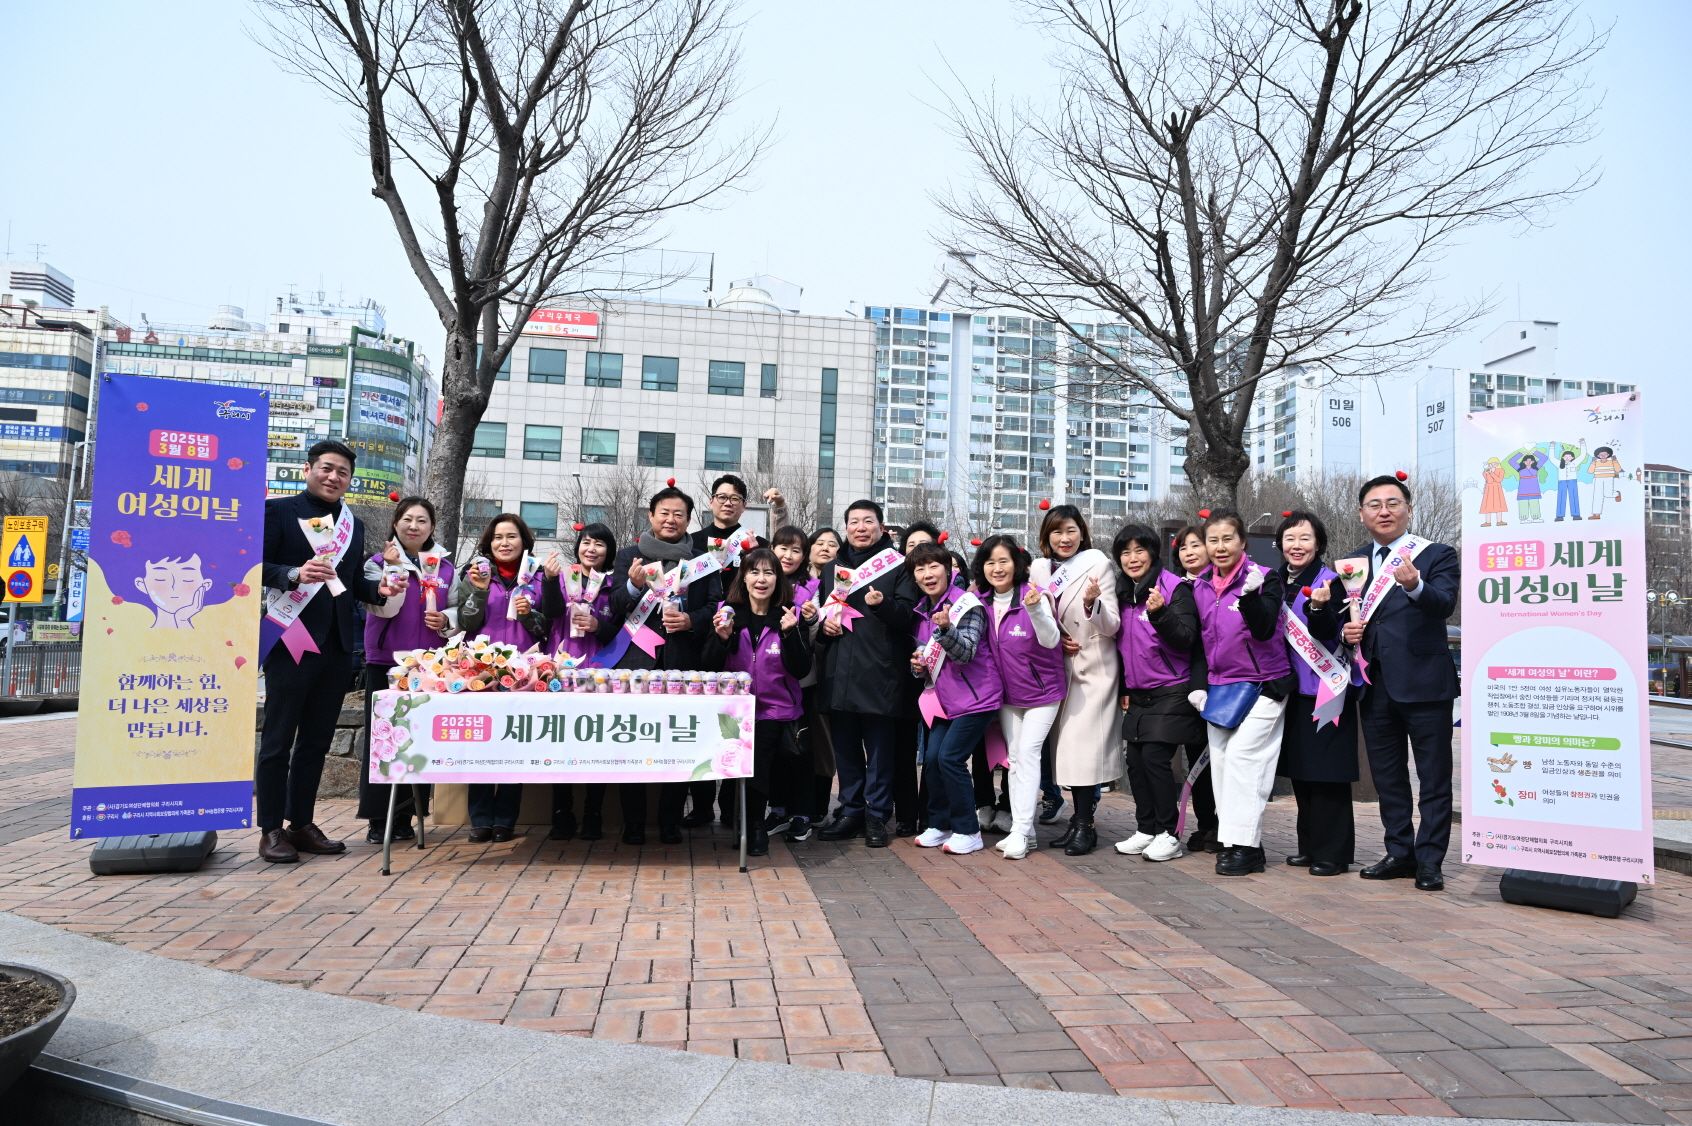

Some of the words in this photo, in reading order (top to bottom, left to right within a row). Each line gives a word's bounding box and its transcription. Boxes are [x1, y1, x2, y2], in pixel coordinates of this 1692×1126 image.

[537, 311, 583, 322] 구리우체국
[546, 324, 569, 335] 365
[1332, 416, 1351, 428] 506
[1427, 419, 1444, 434] 507
[161, 431, 210, 446] 2025년
[159, 443, 182, 456] 3월
[187, 445, 210, 459] 8일
[150, 464, 212, 492] 세계
[362, 479, 386, 491] TMS
[7, 520, 45, 531] 노인보호구역
[1486, 542, 1538, 555] 2025년
[1549, 539, 1622, 568] 세계
[1486, 555, 1509, 570] 3월
[1514, 554, 1538, 568] 8일
[1478, 574, 1578, 605] 여성의
[1586, 572, 1627, 602] 날
[1500, 610, 1549, 618] International
[1549, 610, 1586, 618] Women's
[1586, 610, 1603, 619] Day
[1318, 658, 1334, 673] 날
[1528, 668, 1555, 678] 여성의
[1573, 669, 1599, 678] 이란?
[118, 673, 193, 690] 함께하는
[108, 698, 127, 715] 더
[133, 698, 170, 714] 나은
[175, 697, 229, 714] 세상을
[127, 720, 209, 739] 만듭니다.
[440, 715, 485, 728] 2025년
[501, 714, 567, 744] 세계
[574, 713, 662, 743] 여성의
[668, 714, 701, 743] 날
[440, 728, 461, 741] 3월
[464, 728, 485, 741] 8일
[1512, 735, 1531, 744] 빵과
[1533, 736, 1561, 746] 장미의
[1563, 738, 1596, 747] 의미는?
[1522, 760, 1532, 770] 빵
[1517, 790, 1537, 801] 장미
[1542, 797, 1556, 805] 의미
